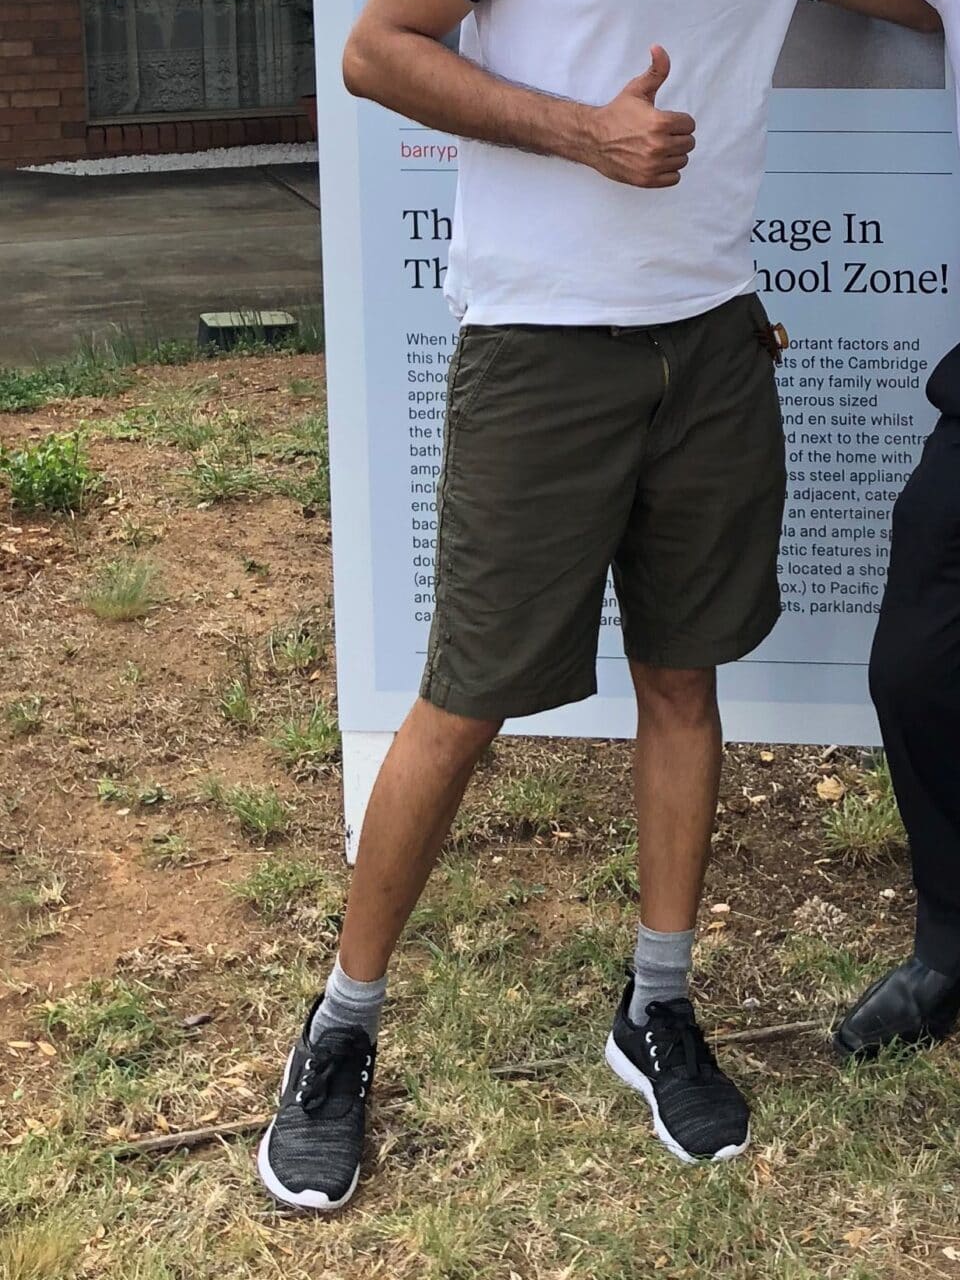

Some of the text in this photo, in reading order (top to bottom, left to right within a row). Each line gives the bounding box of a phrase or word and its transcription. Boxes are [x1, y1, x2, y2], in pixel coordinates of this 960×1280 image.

[401, 141, 458, 163] barryp
[843, 213, 884, 244] In
[843, 262, 949, 295] Zone!
[406, 332, 447, 346] When
[838, 337, 889, 351] factors
[893, 338, 920, 351] and
[407, 352, 433, 365] this
[801, 355, 816, 369] of
[820, 356, 844, 369] the
[848, 356, 928, 373] Cambridge
[799, 377, 825, 390] any
[829, 375, 872, 391] family
[876, 376, 920, 389] would
[839, 393, 878, 407] sized
[808, 414, 826, 426] en
[831, 412, 866, 426] suite
[871, 413, 914, 427] whilst
[409, 425, 433, 439] the
[801, 432, 833, 444] next
[837, 432, 851, 444] to
[856, 432, 880, 445] the
[789, 450, 803, 463] of
[808, 450, 832, 463] the
[836, 450, 877, 464] home
[881, 451, 912, 464] with
[809, 469, 845, 482] steel
[793, 487, 861, 503] adjacent,
[788, 508, 806, 520] an
[810, 507, 891, 521] entertainer
[800, 525, 827, 538] and
[831, 526, 876, 543] ample
[778, 543, 808, 556] stic
[811, 543, 872, 558] features
[788, 562, 842, 576] located
[846, 565, 855, 576] a
[812, 582, 826, 594] to
[830, 581, 879, 595] Pacific
[810, 599, 881, 616] parklands
